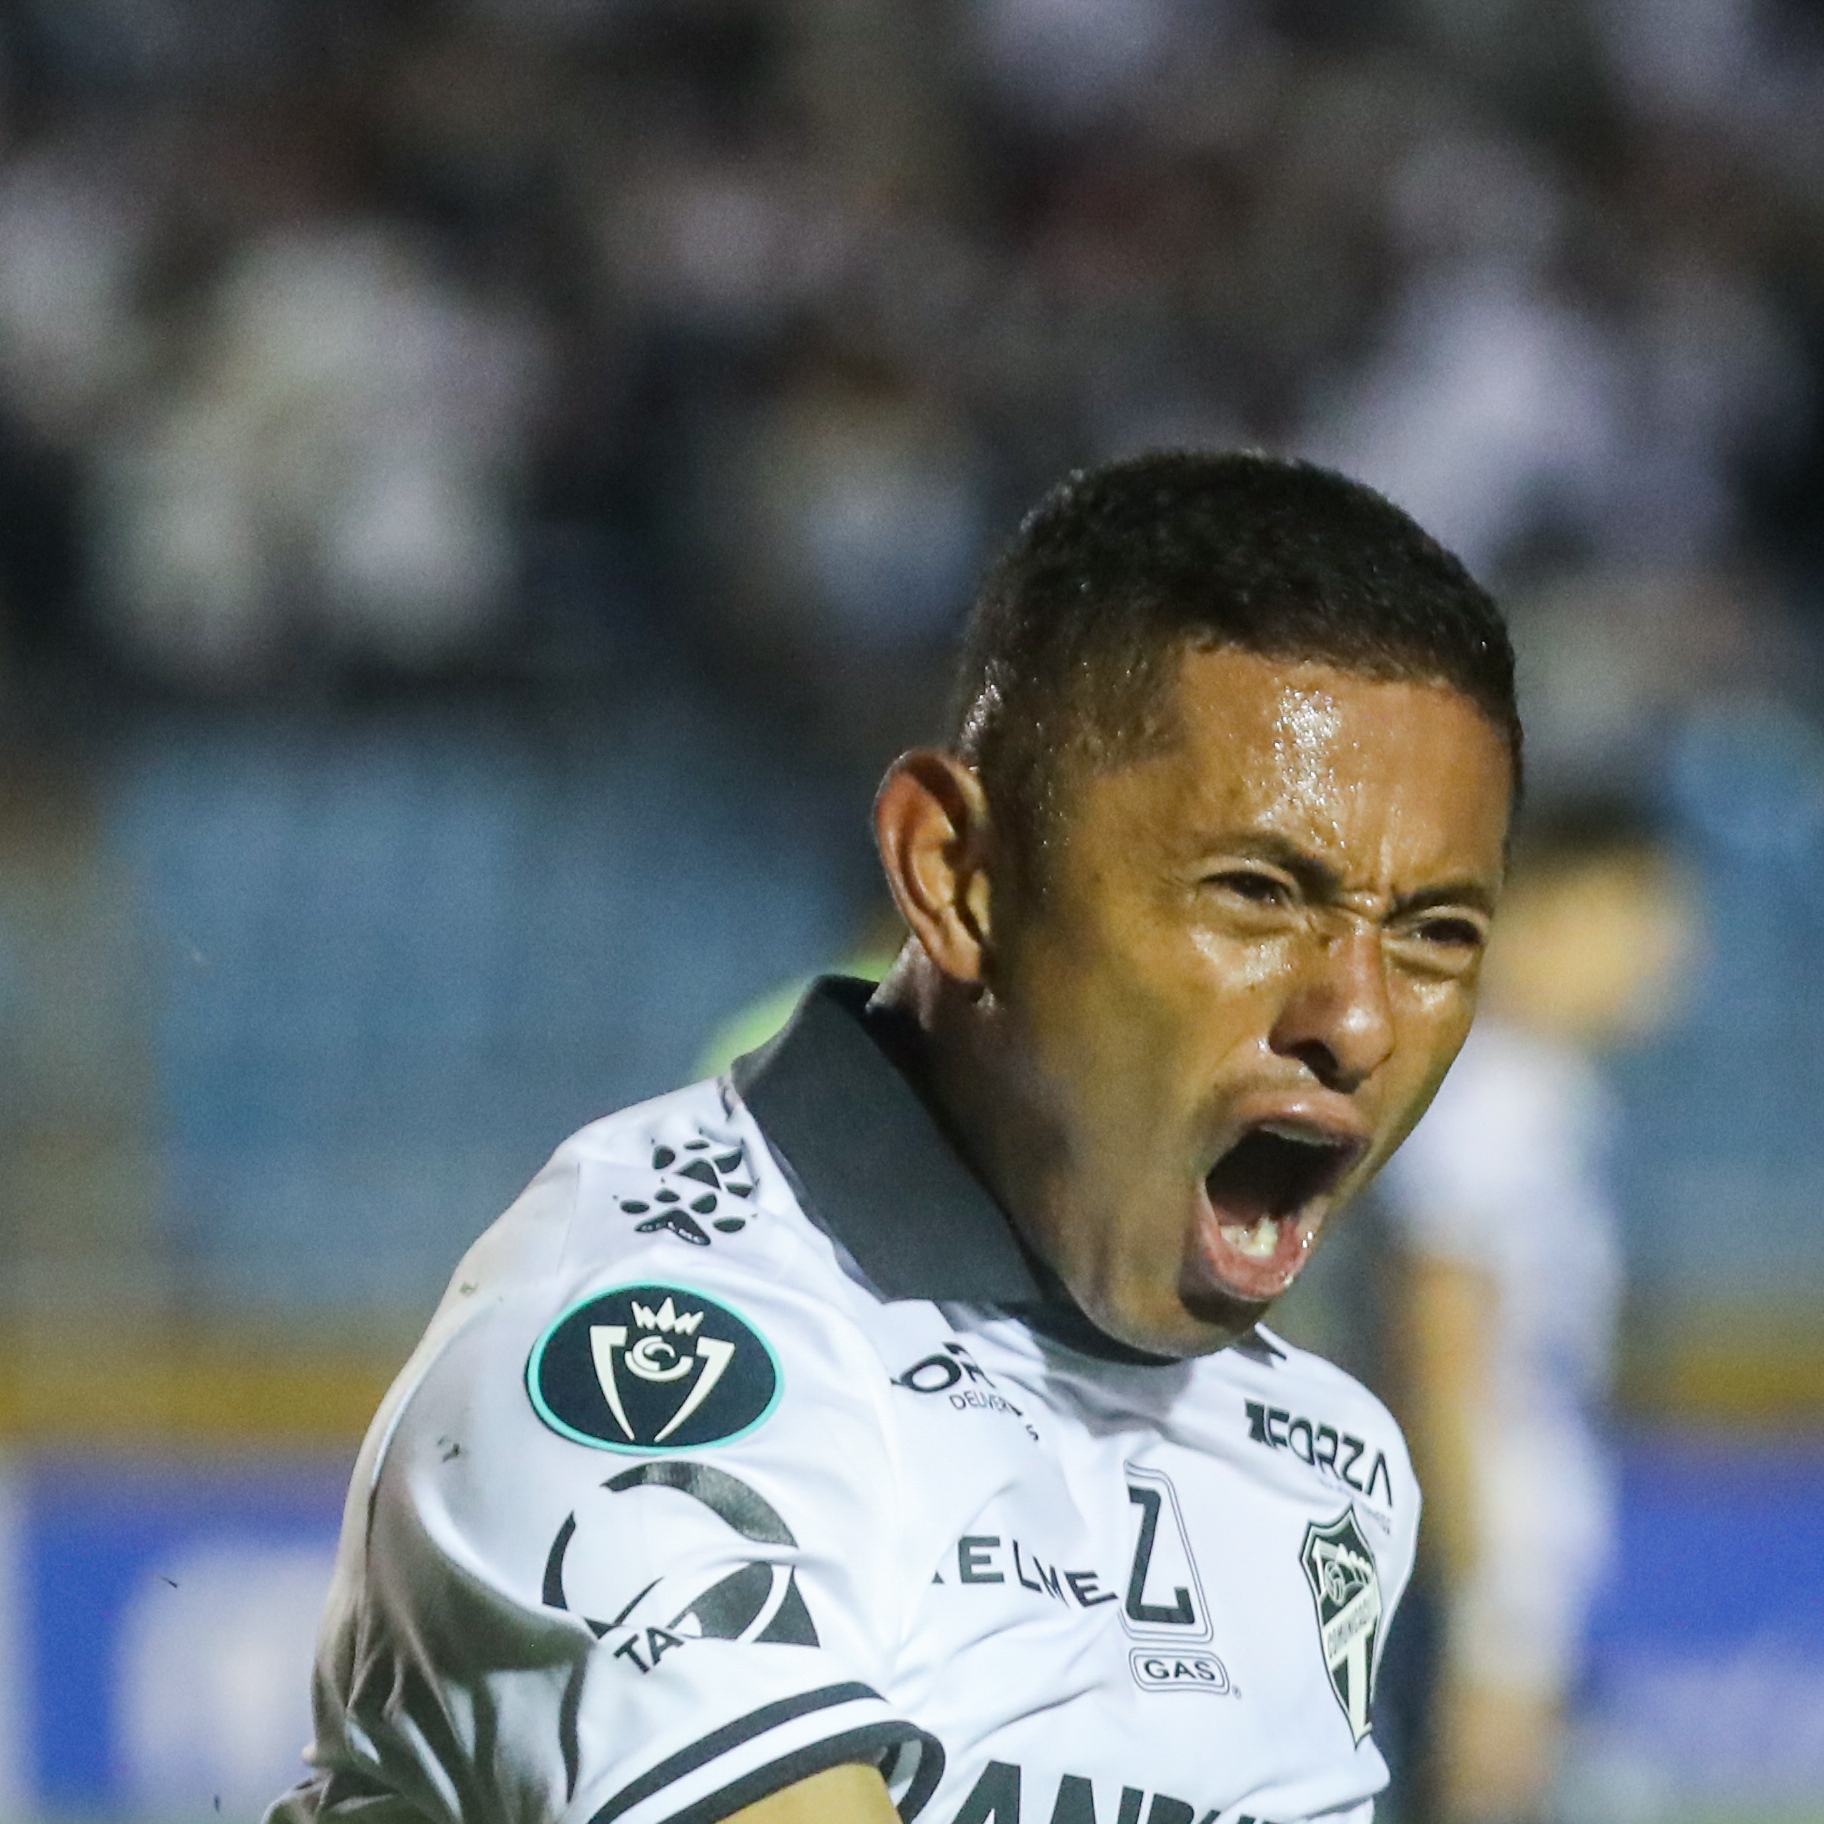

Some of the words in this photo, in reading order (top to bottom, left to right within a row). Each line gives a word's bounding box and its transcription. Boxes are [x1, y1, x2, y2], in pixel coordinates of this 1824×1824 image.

[1264, 1403, 1393, 1507] FORZA
[931, 1535, 1119, 1609] ELME
[1127, 1486, 1195, 1624] Z
[613, 1627, 685, 1674] TA
[1143, 1659, 1215, 1681] GAS
